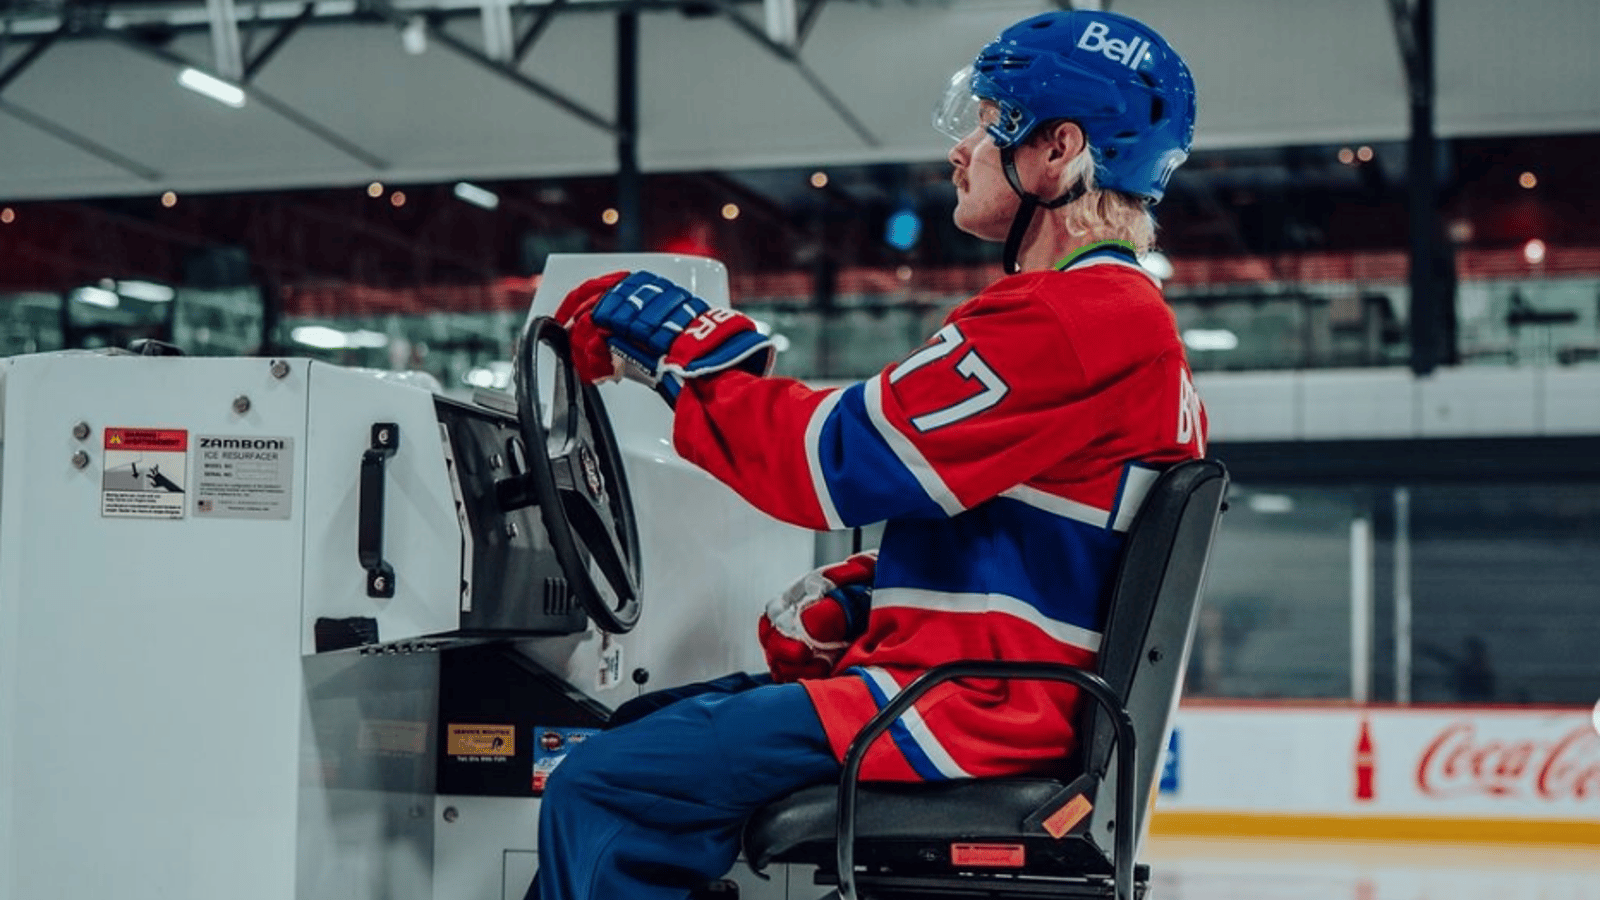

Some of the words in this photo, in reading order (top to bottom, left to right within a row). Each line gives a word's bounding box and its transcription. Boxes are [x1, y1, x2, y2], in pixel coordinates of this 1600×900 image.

[1077, 21, 1151, 71] Bell
[888, 322, 1011, 433] 77
[199, 437, 285, 450] ZAMBONI
[204, 450, 219, 460] ICE
[222, 451, 279, 462] RESURFACER
